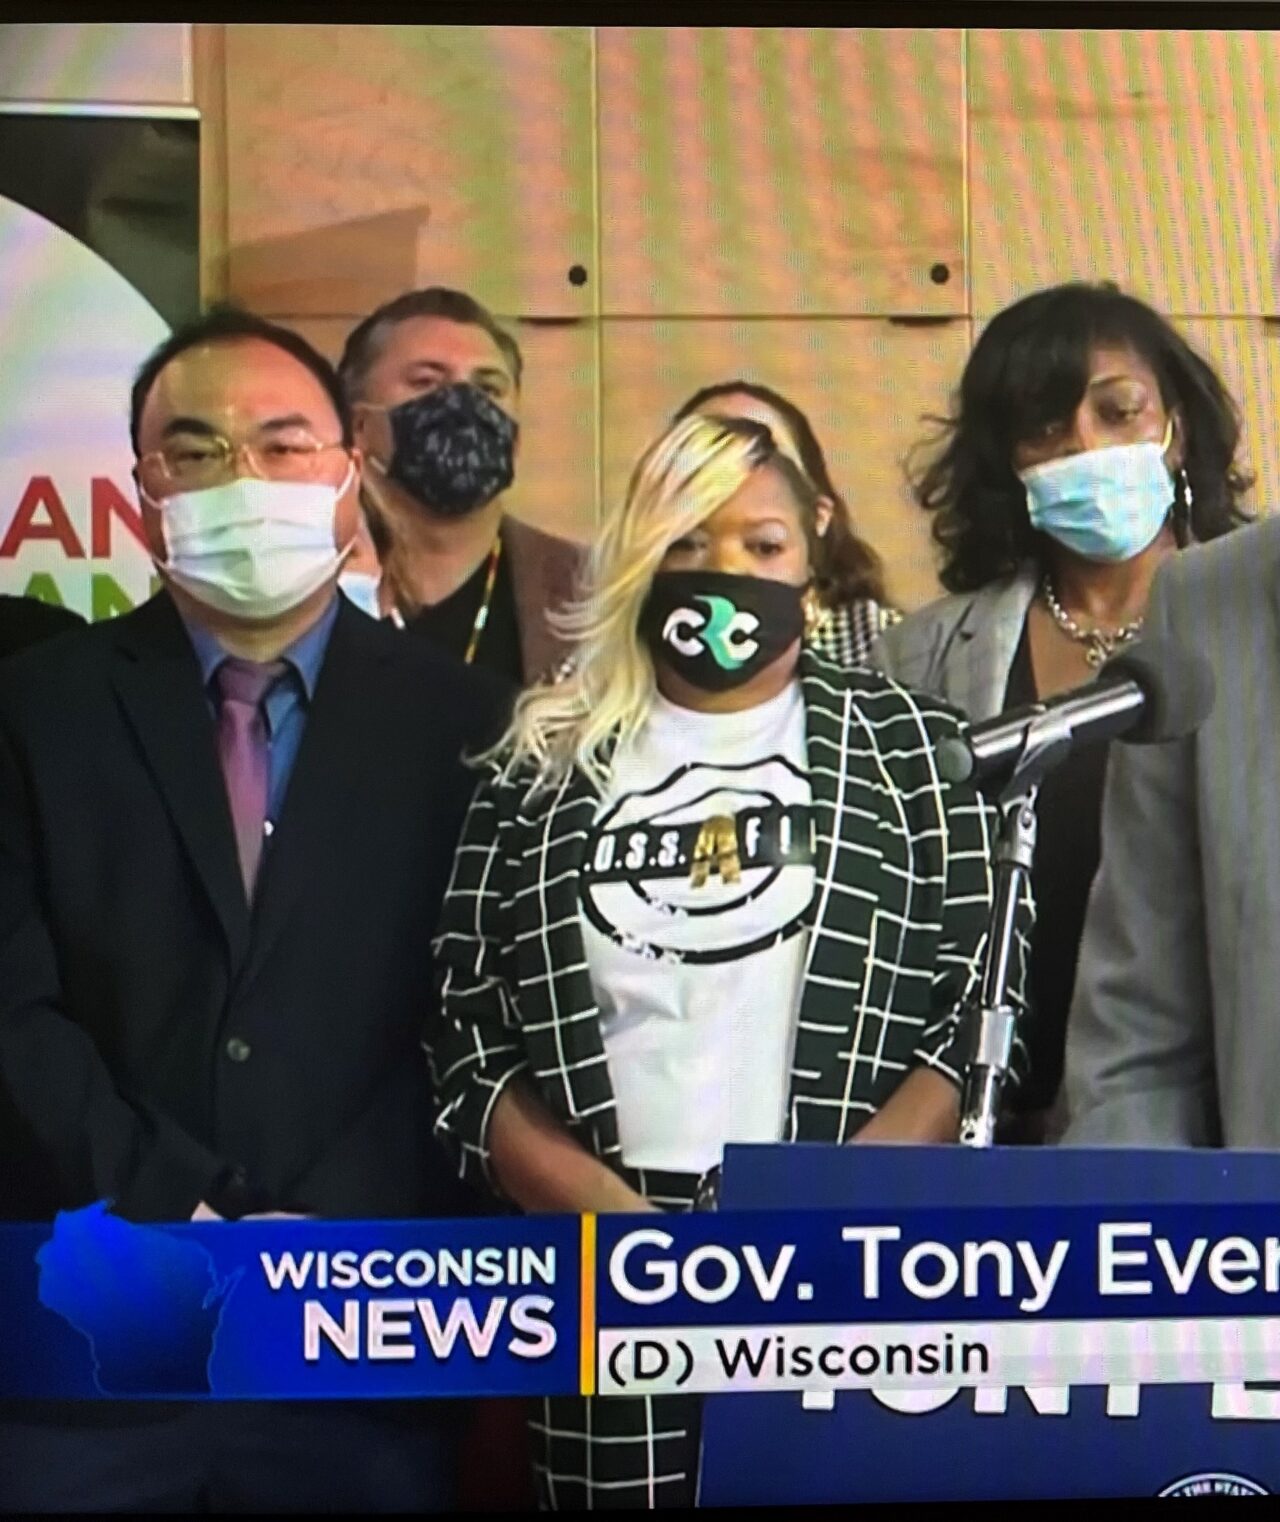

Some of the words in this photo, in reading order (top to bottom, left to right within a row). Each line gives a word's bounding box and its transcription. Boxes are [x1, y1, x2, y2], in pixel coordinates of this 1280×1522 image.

[260, 1246, 557, 1289] WISCONSIN
[609, 1229, 813, 1304] Gov.
[842, 1225, 1070, 1312] Tony
[304, 1293, 558, 1361] NEWS
[608, 1339, 695, 1387] (D)
[715, 1333, 989, 1379] Wisconsin
